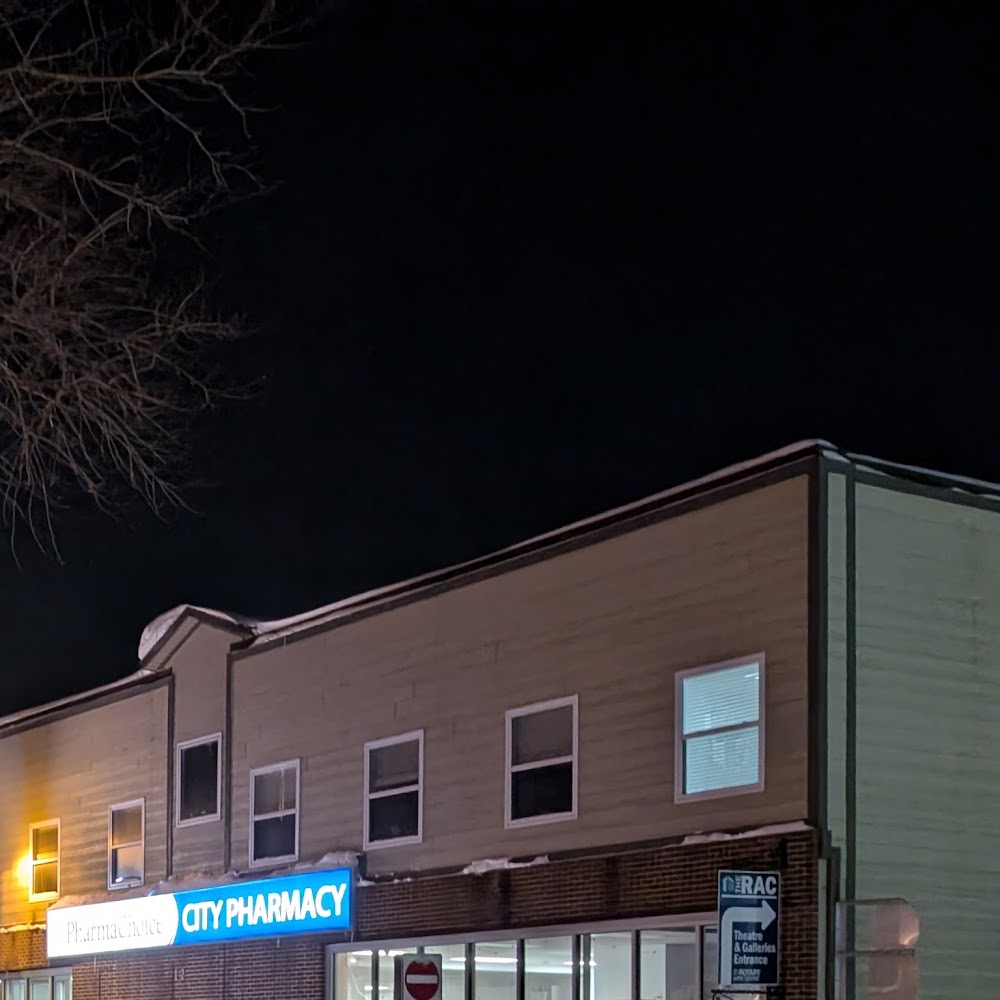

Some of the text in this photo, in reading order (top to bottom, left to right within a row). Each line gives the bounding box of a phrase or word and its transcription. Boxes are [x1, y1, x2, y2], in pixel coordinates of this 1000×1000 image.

[741, 875, 777, 895] RAC
[181, 883, 347, 933] CITY PHARMACY
[66, 914, 163, 944] PharmaChoice
[734, 930, 763, 941] Theatre
[734, 942, 776, 953] & Galleries
[734, 954, 768, 965] Entrance
